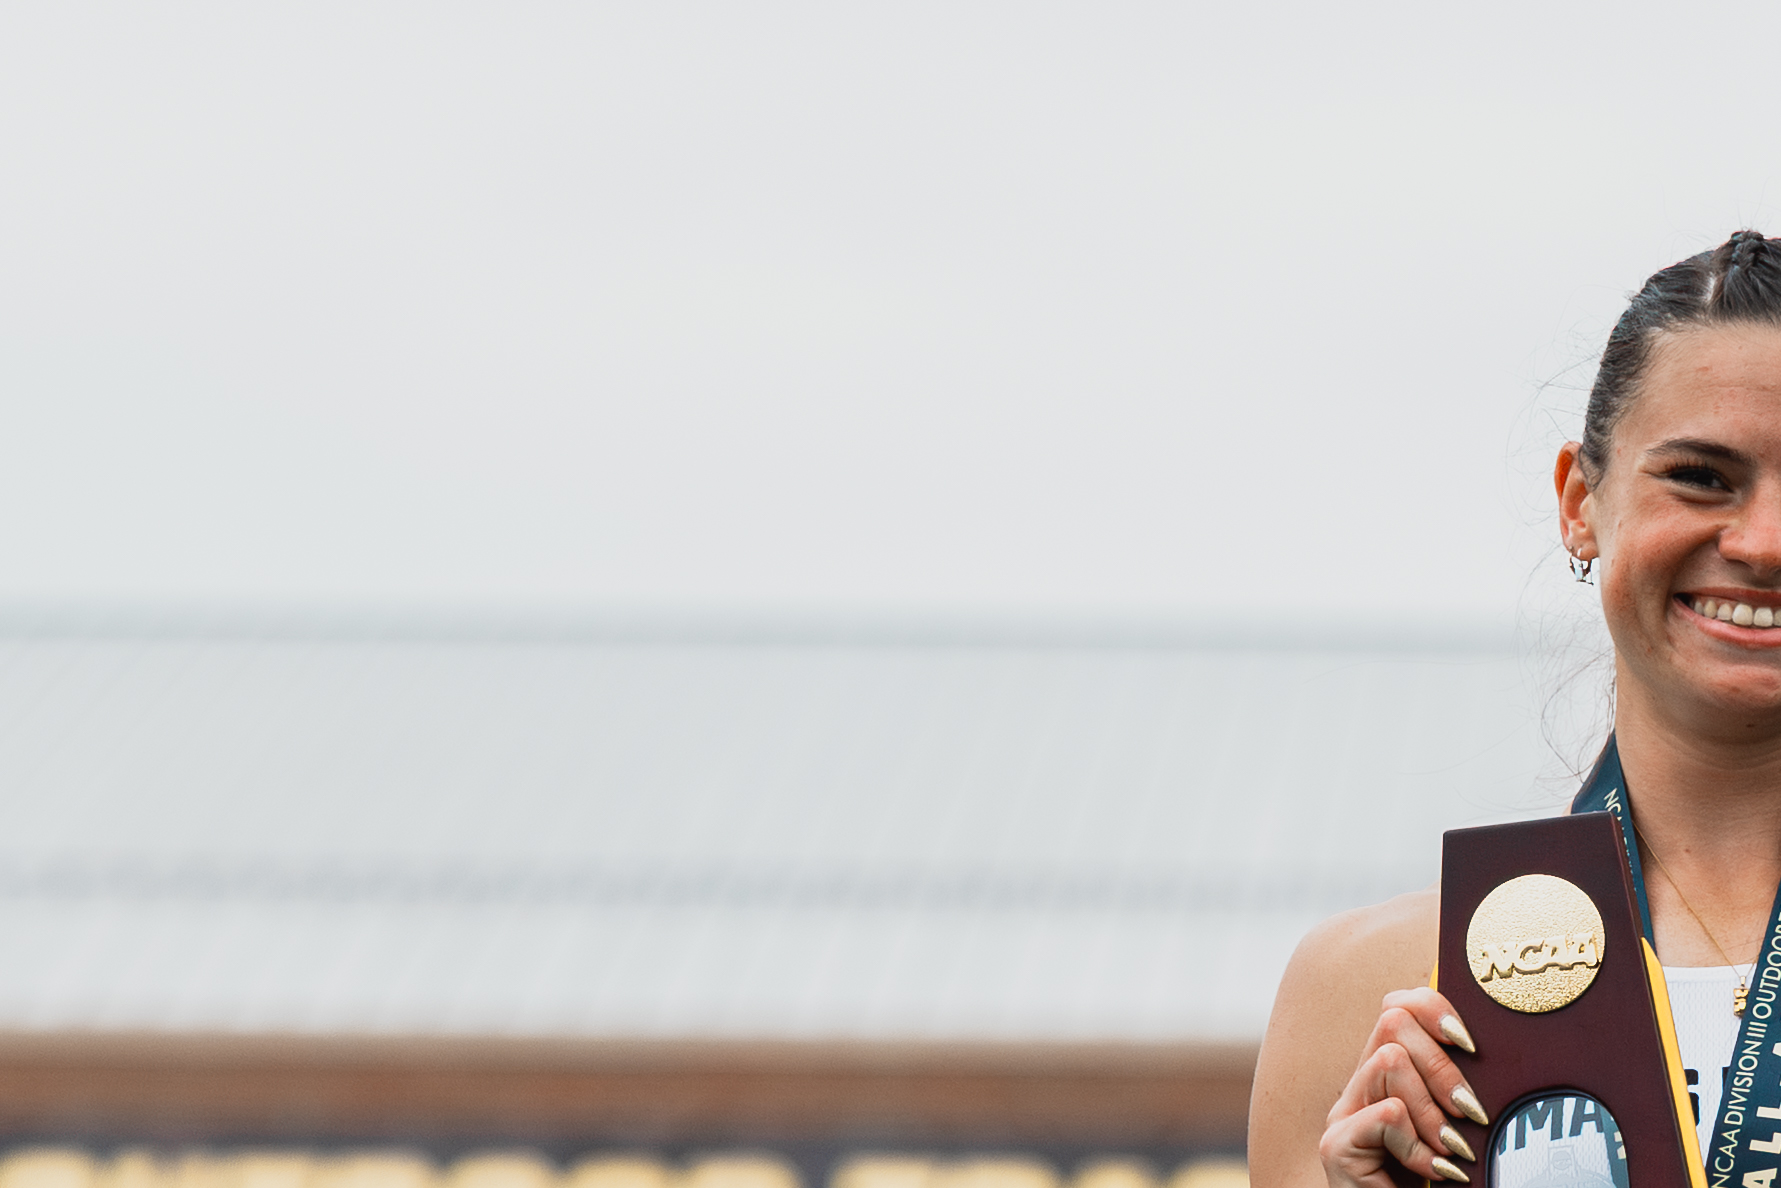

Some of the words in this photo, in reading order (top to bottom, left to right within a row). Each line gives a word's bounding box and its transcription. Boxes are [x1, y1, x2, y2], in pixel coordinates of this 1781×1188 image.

[1480, 932, 1602, 983] NCAA
[1725, 1039, 1762, 1126] DIVISION
[1747, 1022, 1768, 1044] III
